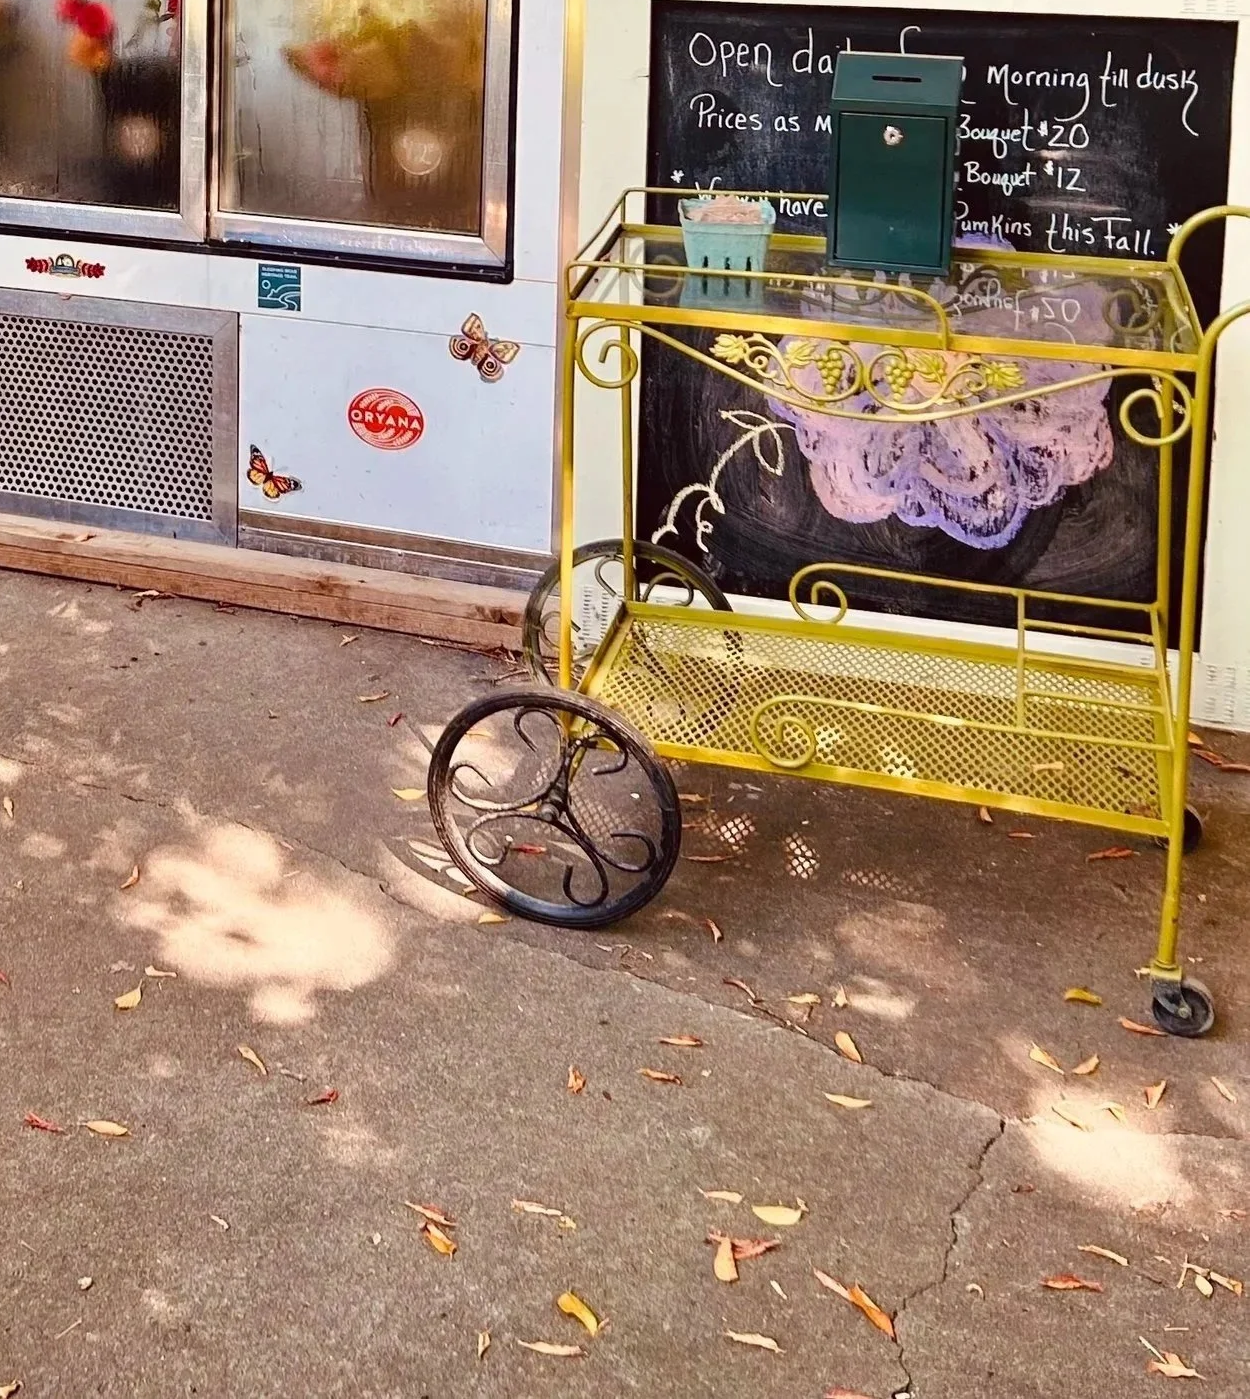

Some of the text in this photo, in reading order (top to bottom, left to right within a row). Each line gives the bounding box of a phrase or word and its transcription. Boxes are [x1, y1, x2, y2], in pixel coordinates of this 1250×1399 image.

[688, 31, 784, 88] Open
[1098, 50, 1129, 108] till
[689, 93, 764, 131] Prices
[774, 114, 801, 132] as
[1036, 120, 1090, 149] $20
[963, 160, 1087, 197] Bouquet $12
[779, 190, 829, 218] have
[1045, 213, 1096, 253] this
[350, 409, 422, 431] ORYANA
